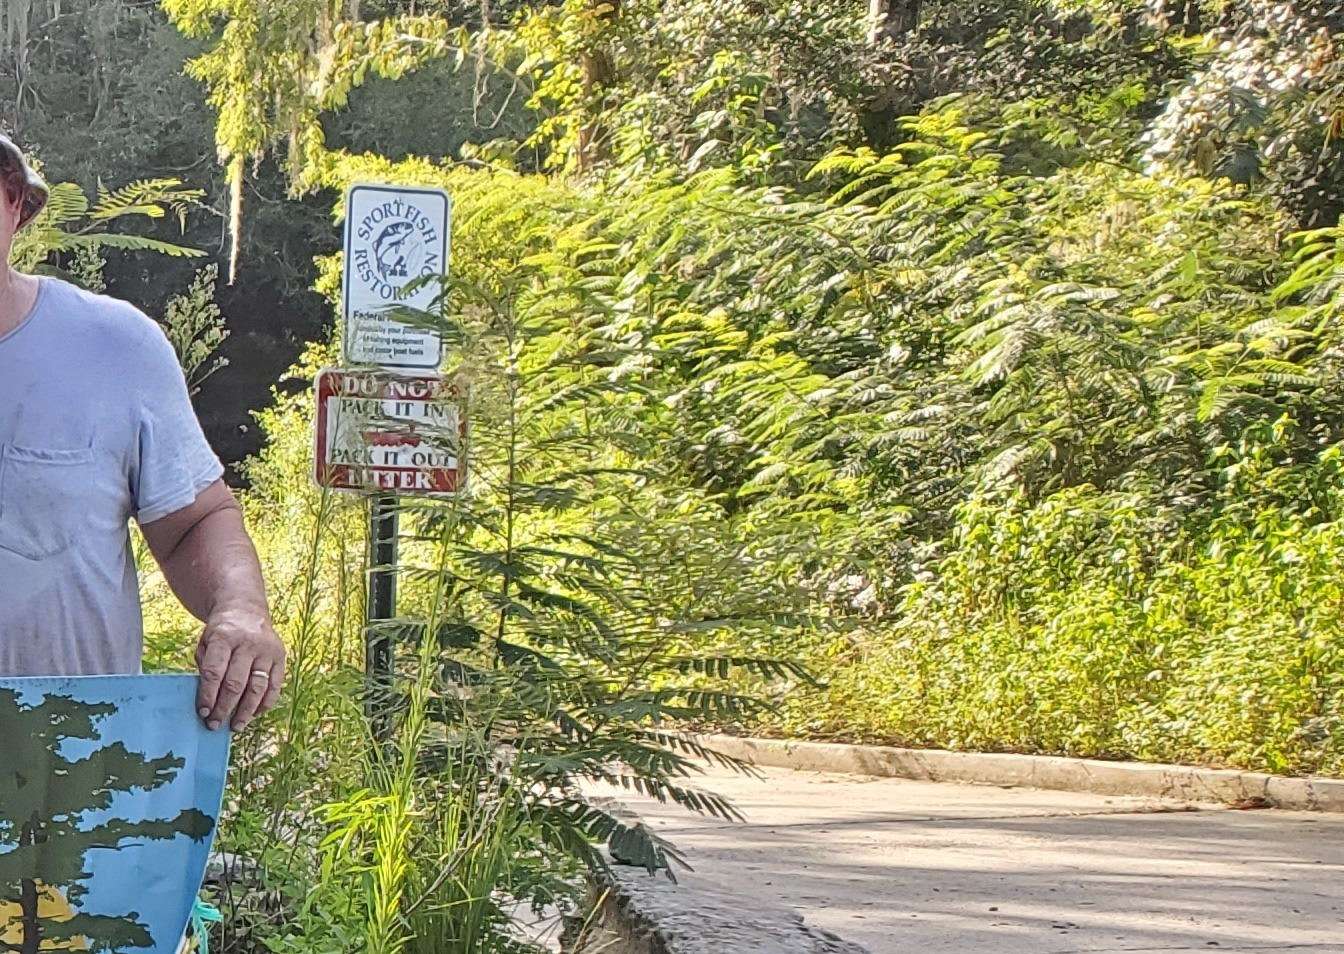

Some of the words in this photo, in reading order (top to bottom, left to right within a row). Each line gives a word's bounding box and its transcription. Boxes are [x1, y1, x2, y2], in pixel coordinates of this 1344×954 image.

[344, 376, 378, 394] DO
[341, 399, 385, 416] PACK
[395, 402, 414, 416] IT
[423, 403, 445, 418] IN
[384, 451, 400, 465] IT
